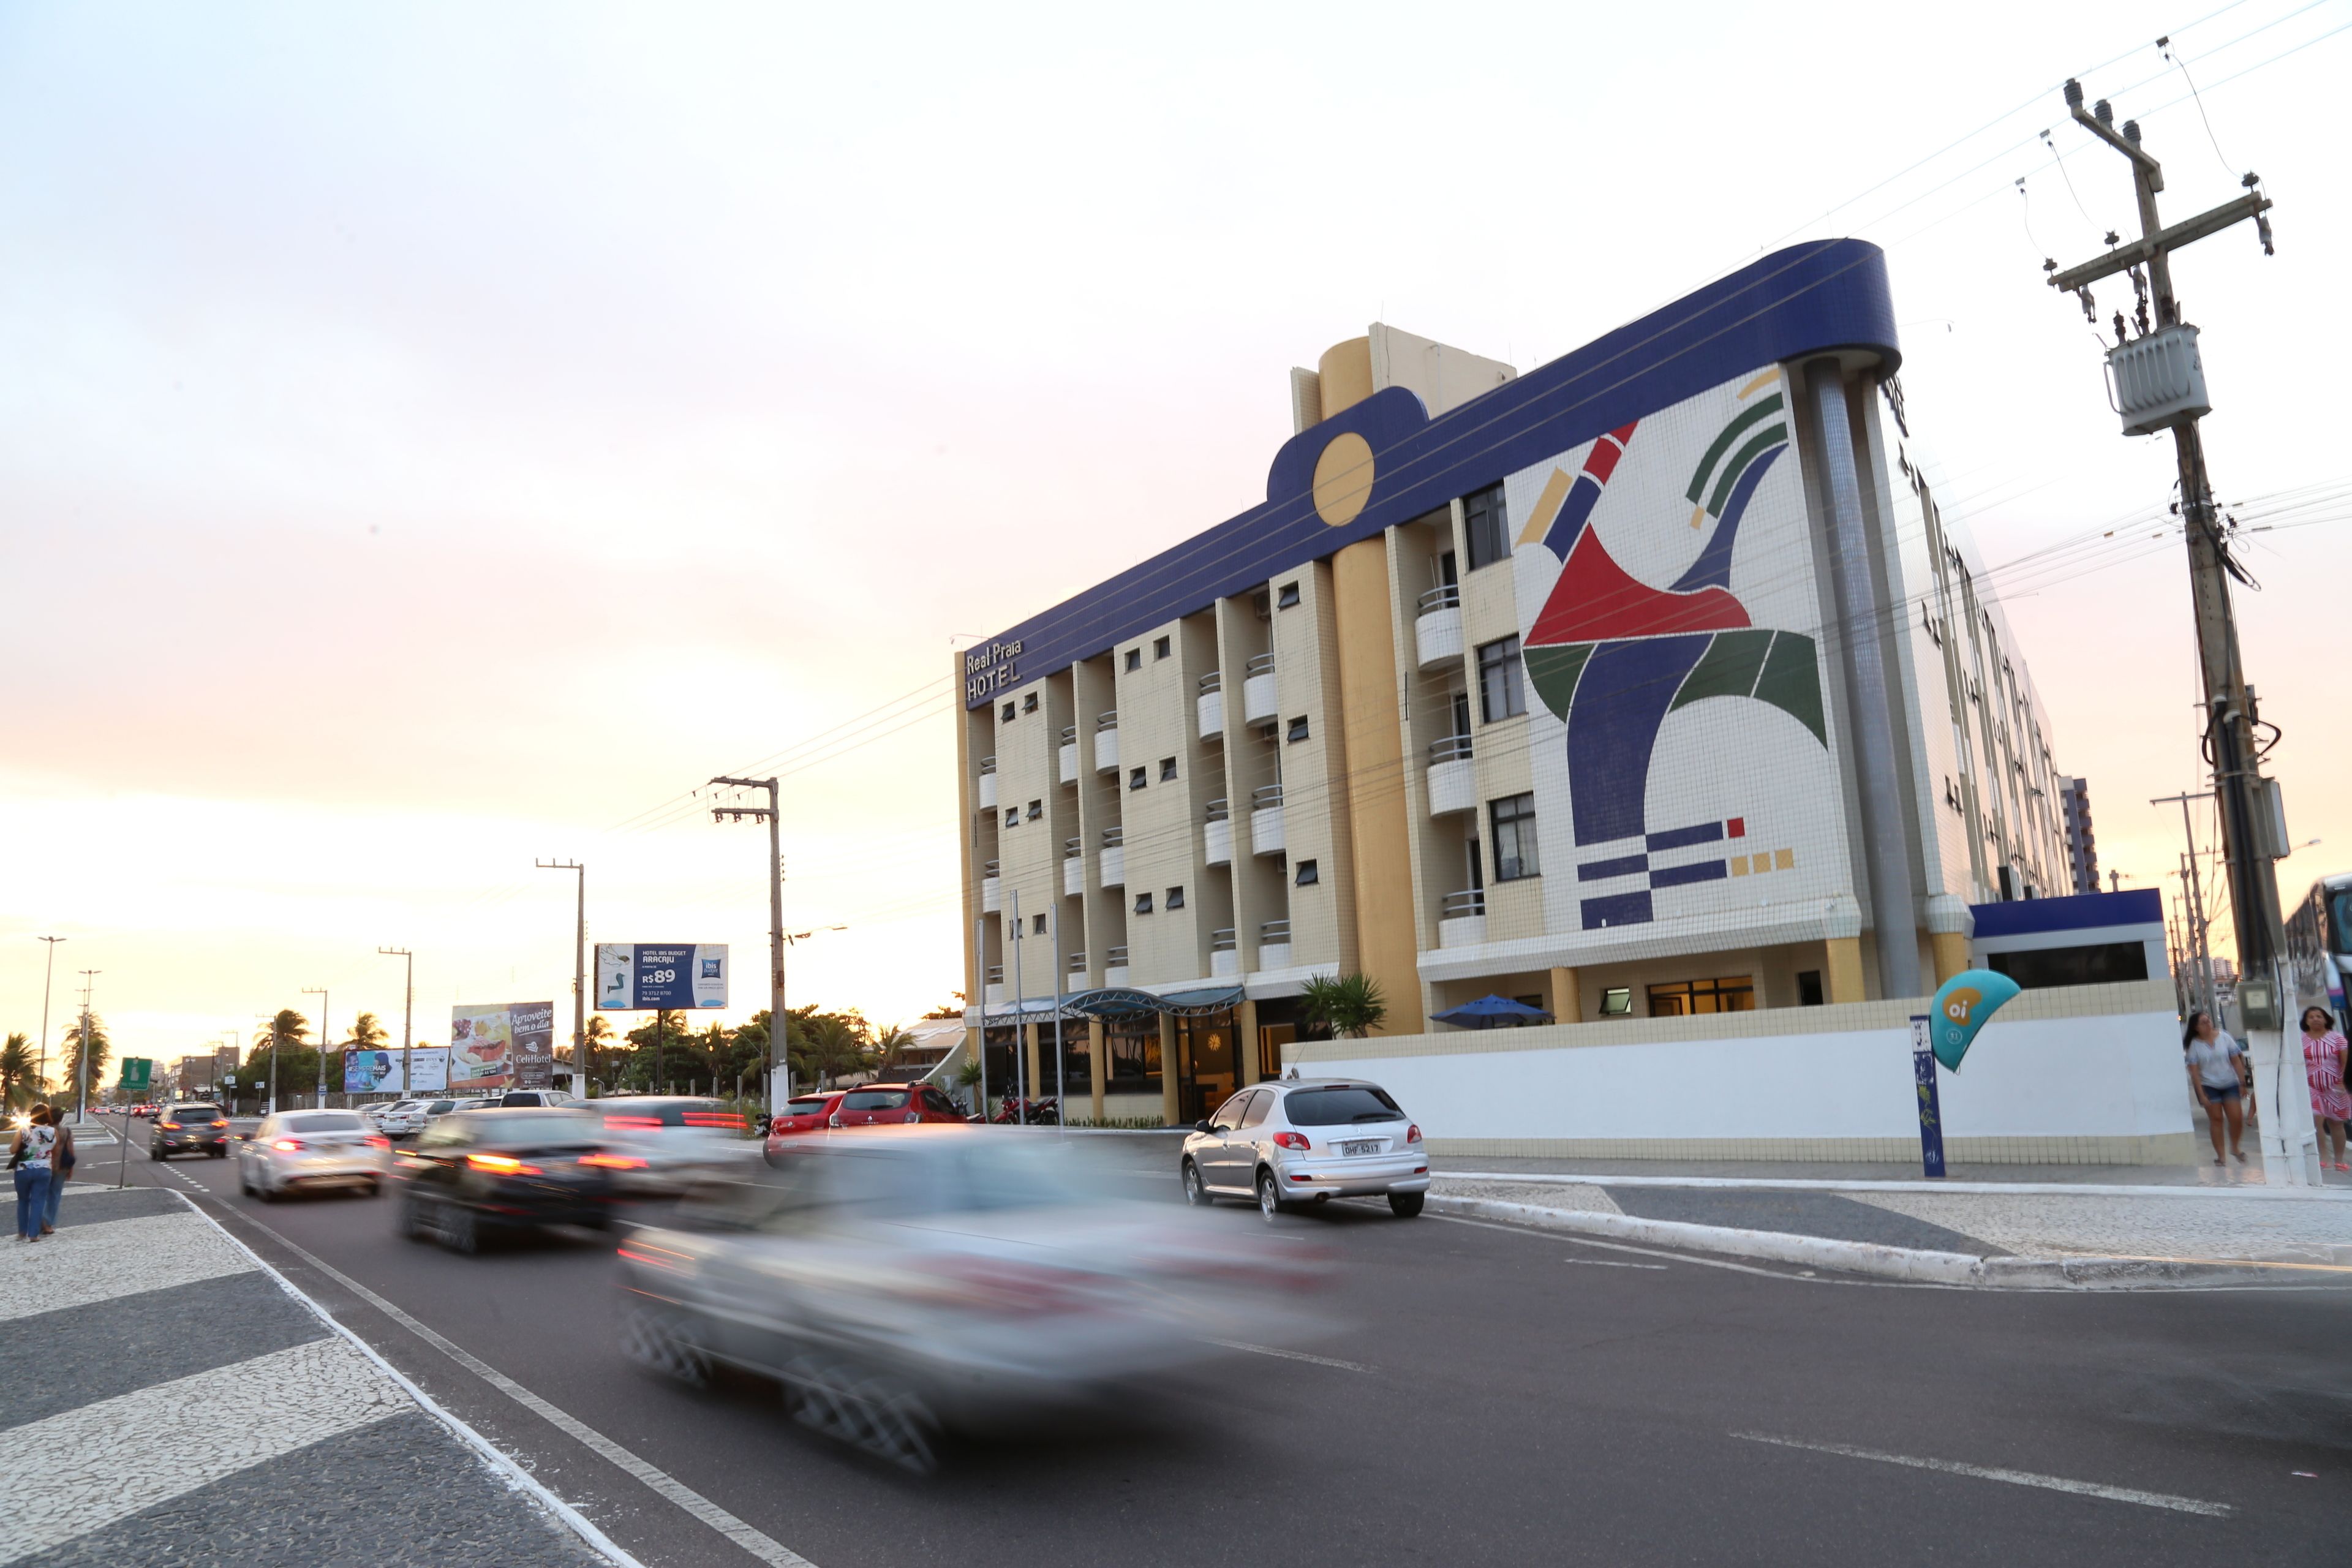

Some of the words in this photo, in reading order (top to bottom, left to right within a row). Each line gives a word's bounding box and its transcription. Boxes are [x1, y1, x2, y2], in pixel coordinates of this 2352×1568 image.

[967, 646, 990, 675] Real
[993, 639, 1022, 664] Praia
[968, 662, 1020, 701] HOTEL
[643, 956, 674, 964] ARACAJU
[511, 1008, 552, 1027] Aproveite
[514, 1025, 530, 1034] bem
[537, 1019, 549, 1029] dia
